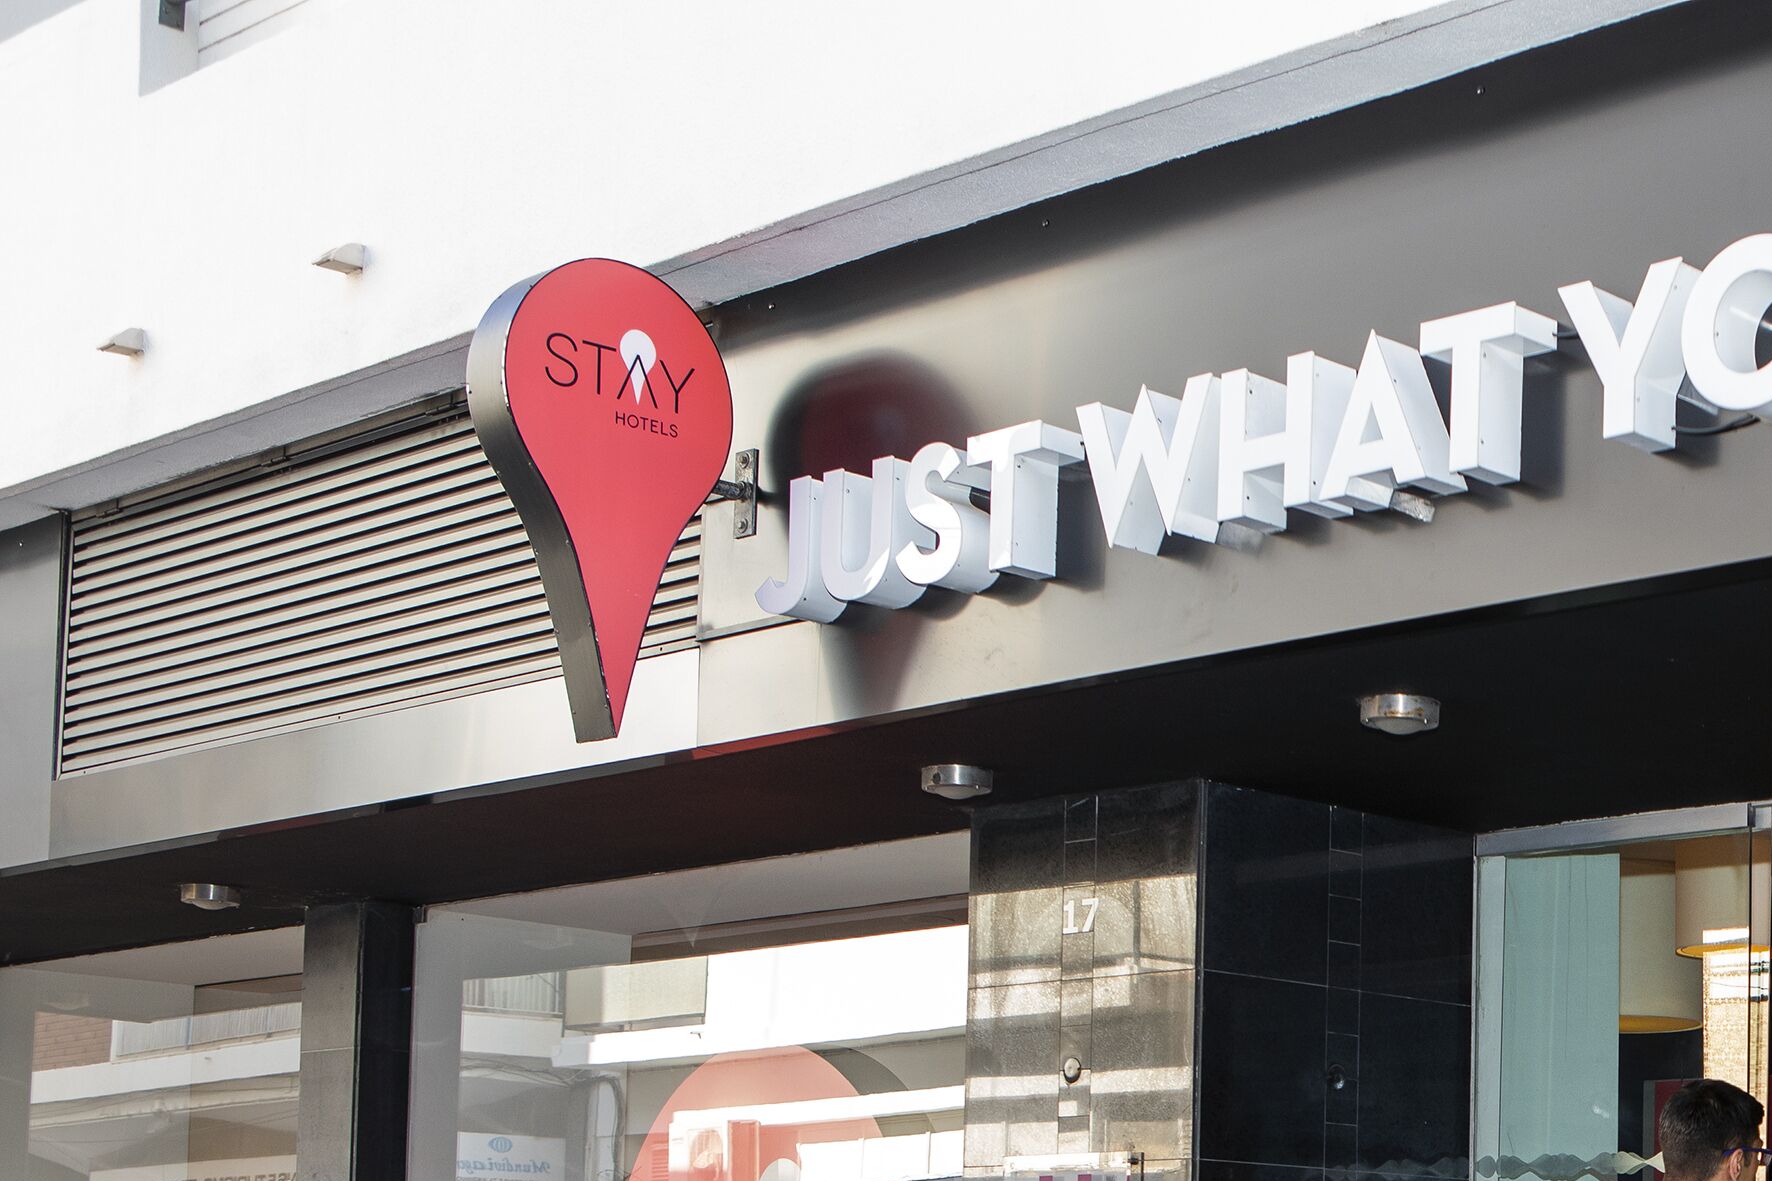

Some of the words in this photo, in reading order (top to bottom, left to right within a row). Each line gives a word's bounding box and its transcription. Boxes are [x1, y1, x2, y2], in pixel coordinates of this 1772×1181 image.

[545, 332, 695, 414] STAY
[615, 411, 678, 438] HOTELS
[756, 420, 1080, 622] JUST
[1076, 302, 1556, 555] WHAT
[1062, 898, 1098, 933] 17
